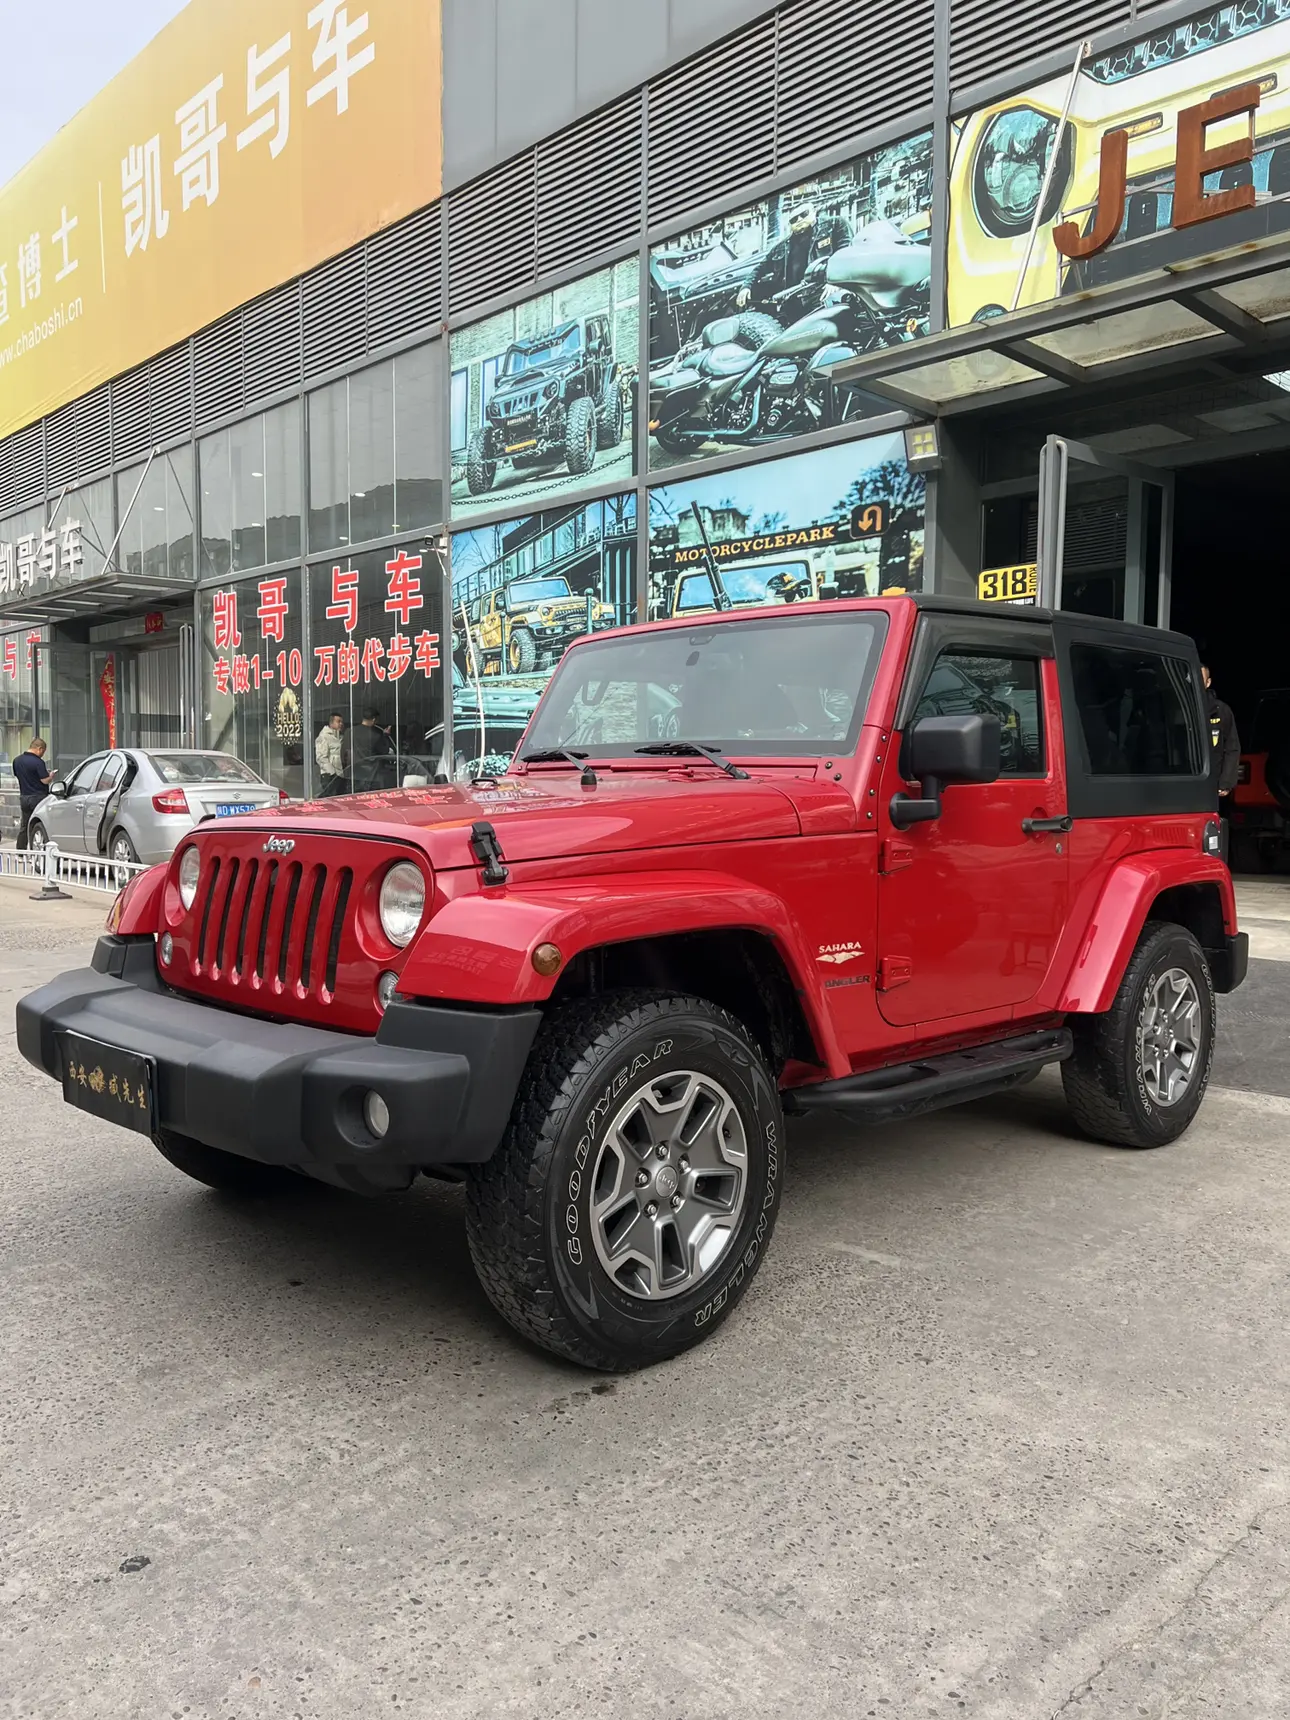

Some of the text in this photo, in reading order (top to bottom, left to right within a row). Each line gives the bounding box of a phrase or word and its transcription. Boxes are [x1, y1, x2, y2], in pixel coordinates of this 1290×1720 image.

[121, 0, 375, 258] 凯哥与车
[674, 525, 836, 563] MOTORCYCLEPARK
[983, 568, 1027, 599] 318
[213, 551, 423, 651] 凯哥与车
[276, 723, 301, 737] 2022
[277, 712, 300, 724] HELLO
[263, 835, 296, 856] Jeep
[819, 942, 862, 953] SAHARA
[567, 1039, 674, 1265] GOODYEAR
[694, 1121, 778, 1327] WRANGLER
